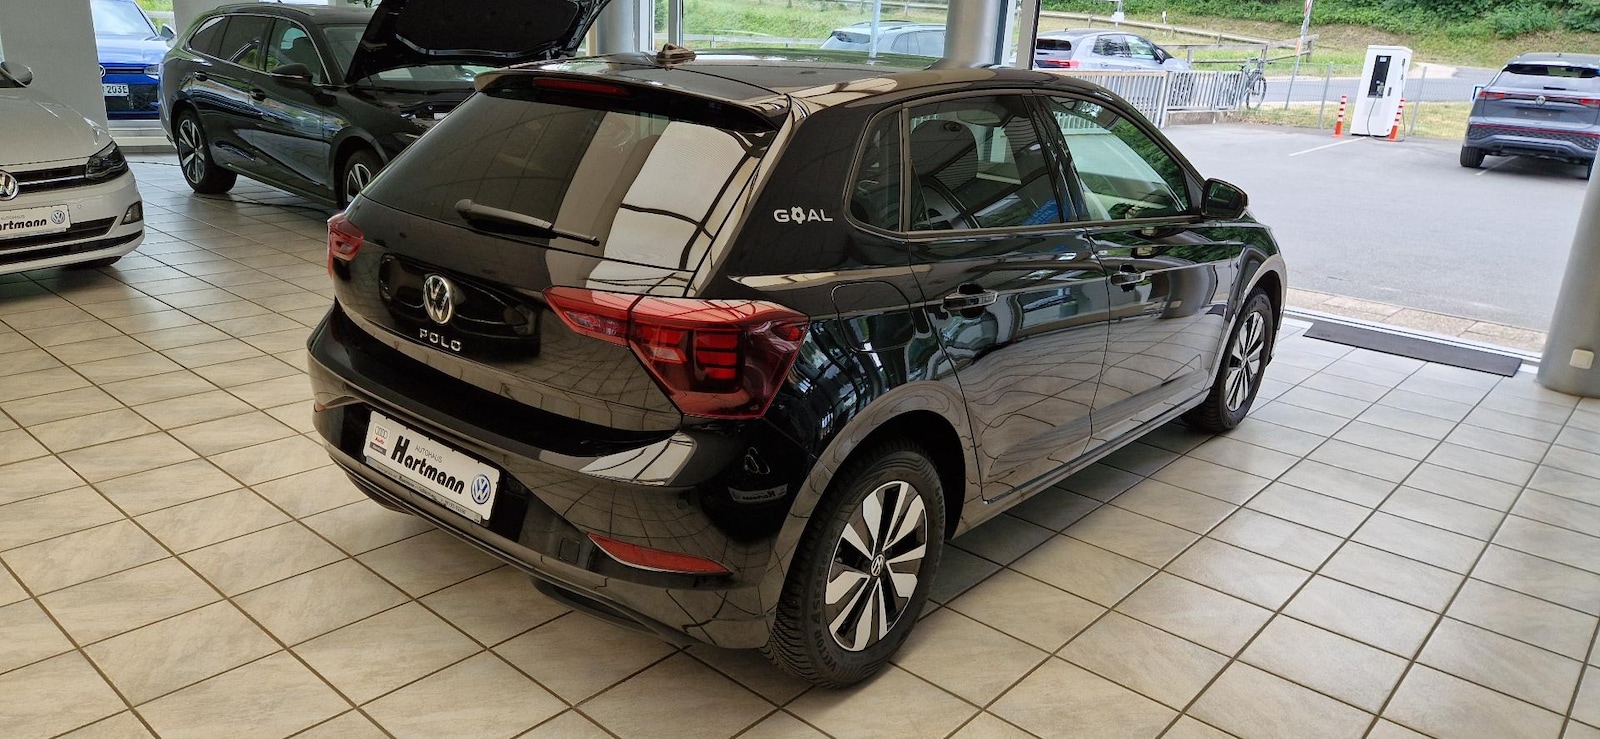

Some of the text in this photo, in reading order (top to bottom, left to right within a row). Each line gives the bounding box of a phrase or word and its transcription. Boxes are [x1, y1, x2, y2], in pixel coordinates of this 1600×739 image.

[773, 206, 834, 224] GOAL
[419, 328, 462, 352] POLO
[390, 435, 465, 495] Hartmann
[414, 444, 443, 464] AUTOHAUS
